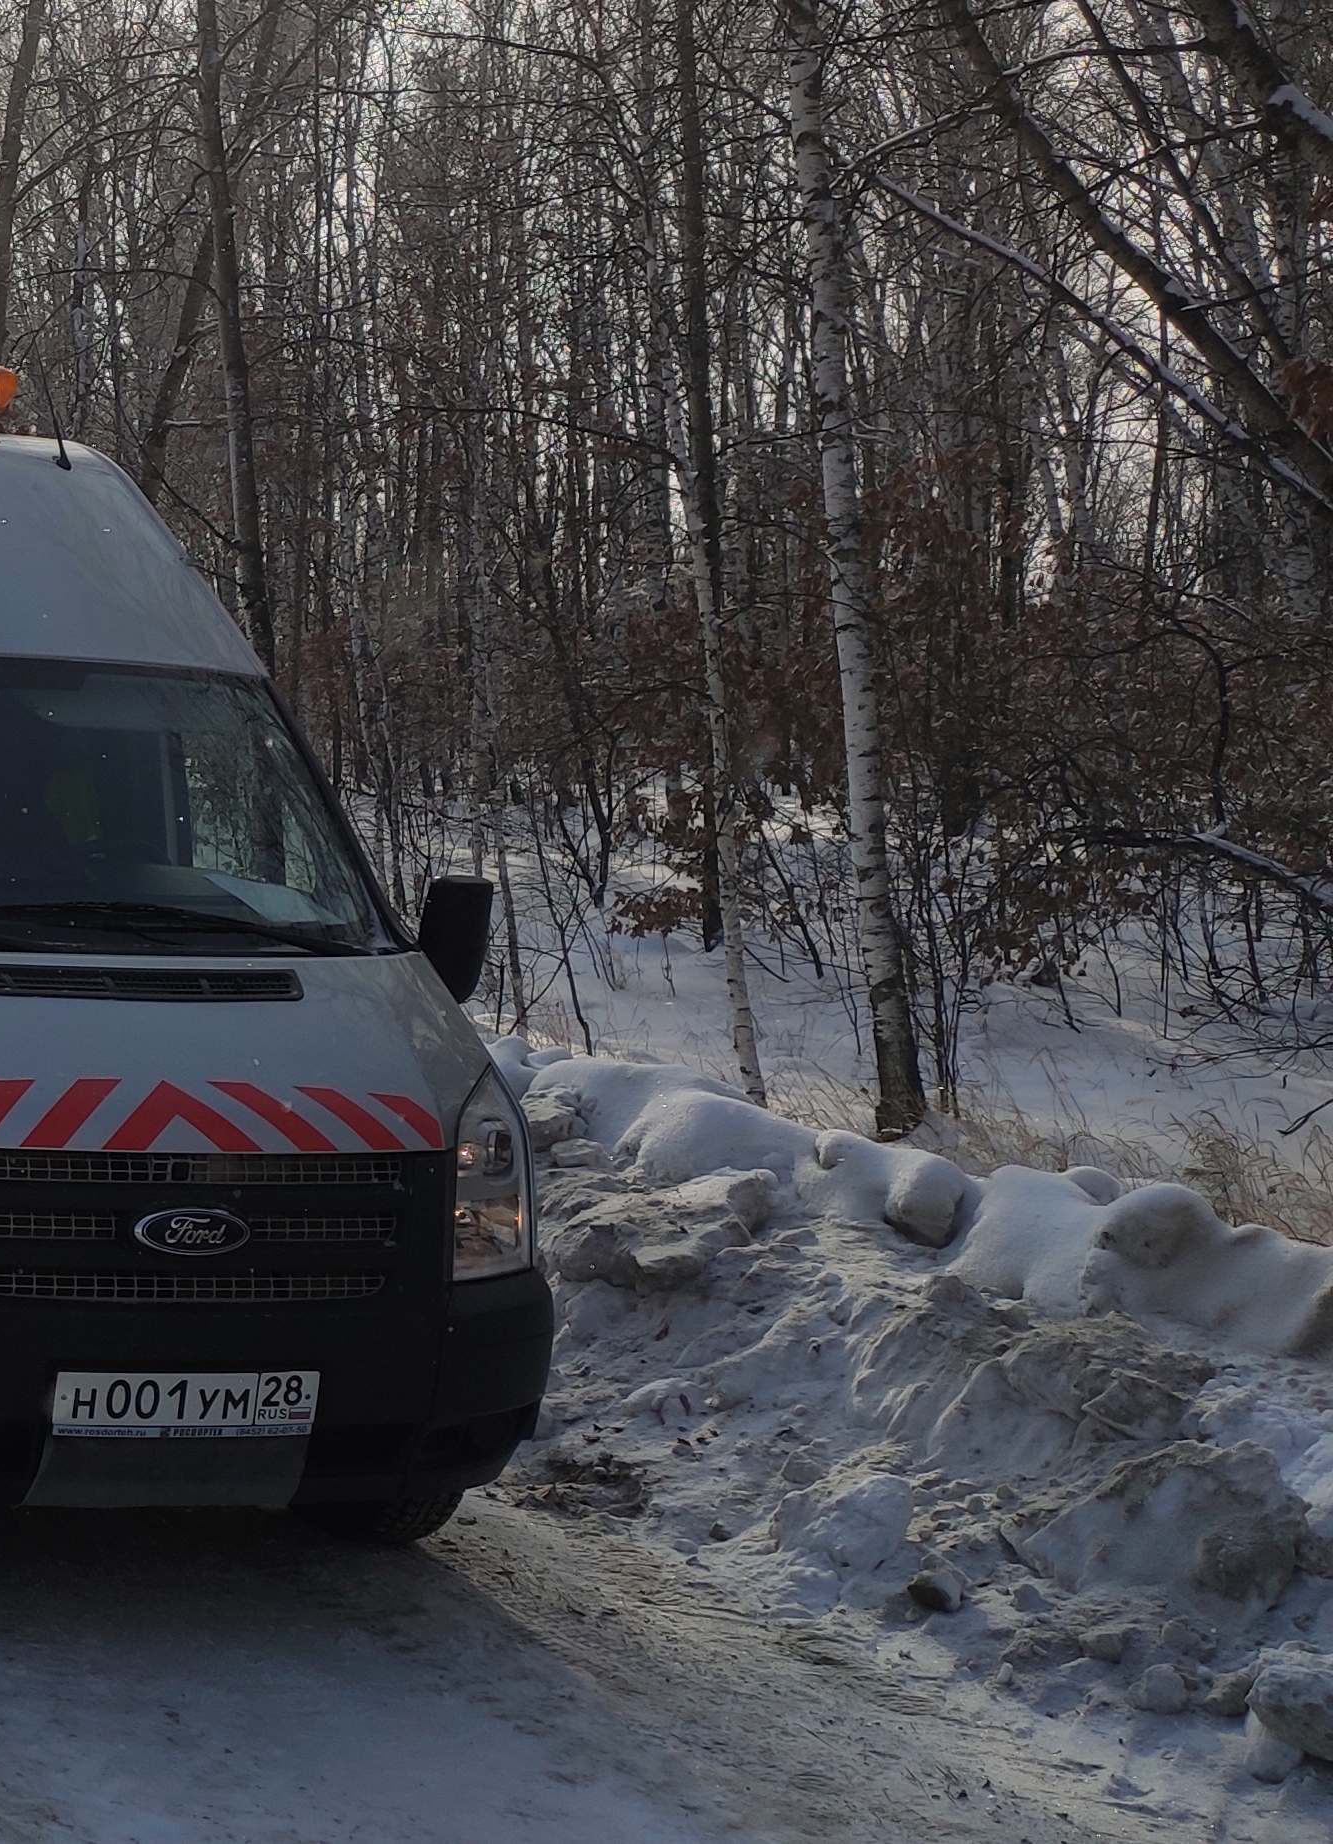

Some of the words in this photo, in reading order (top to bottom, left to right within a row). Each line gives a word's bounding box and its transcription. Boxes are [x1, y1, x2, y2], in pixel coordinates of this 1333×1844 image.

[164, 1215, 227, 1245] Ford
[71, 1378, 251, 1420] Н001УМ
[261, 1375, 303, 1408] 28
[258, 1408, 287, 1420] RUS
[57, 1427, 147, 1437] www.rosdorteh.ru
